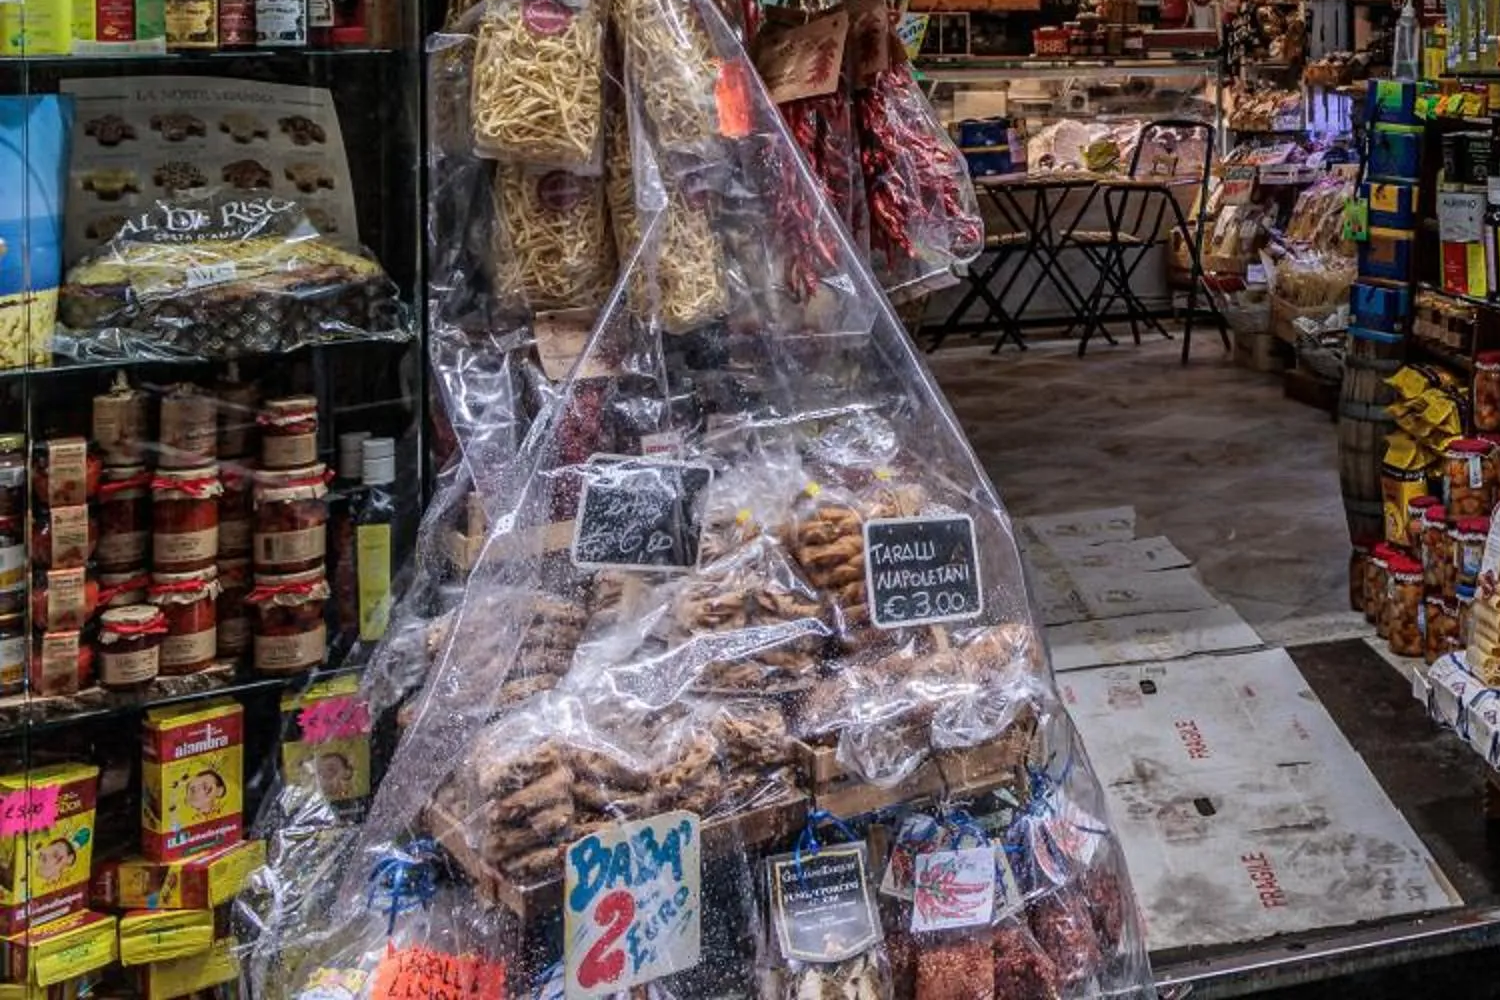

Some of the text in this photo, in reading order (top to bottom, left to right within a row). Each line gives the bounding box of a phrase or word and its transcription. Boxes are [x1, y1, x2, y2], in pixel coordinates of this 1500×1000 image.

[117, 213, 157, 238] AL
[877, 562, 969, 590] NAPOLETANI
[912, 591, 965, 617] 3.00
[1241, 851, 1289, 910] FRAGILE
[576, 889, 636, 989] 2
